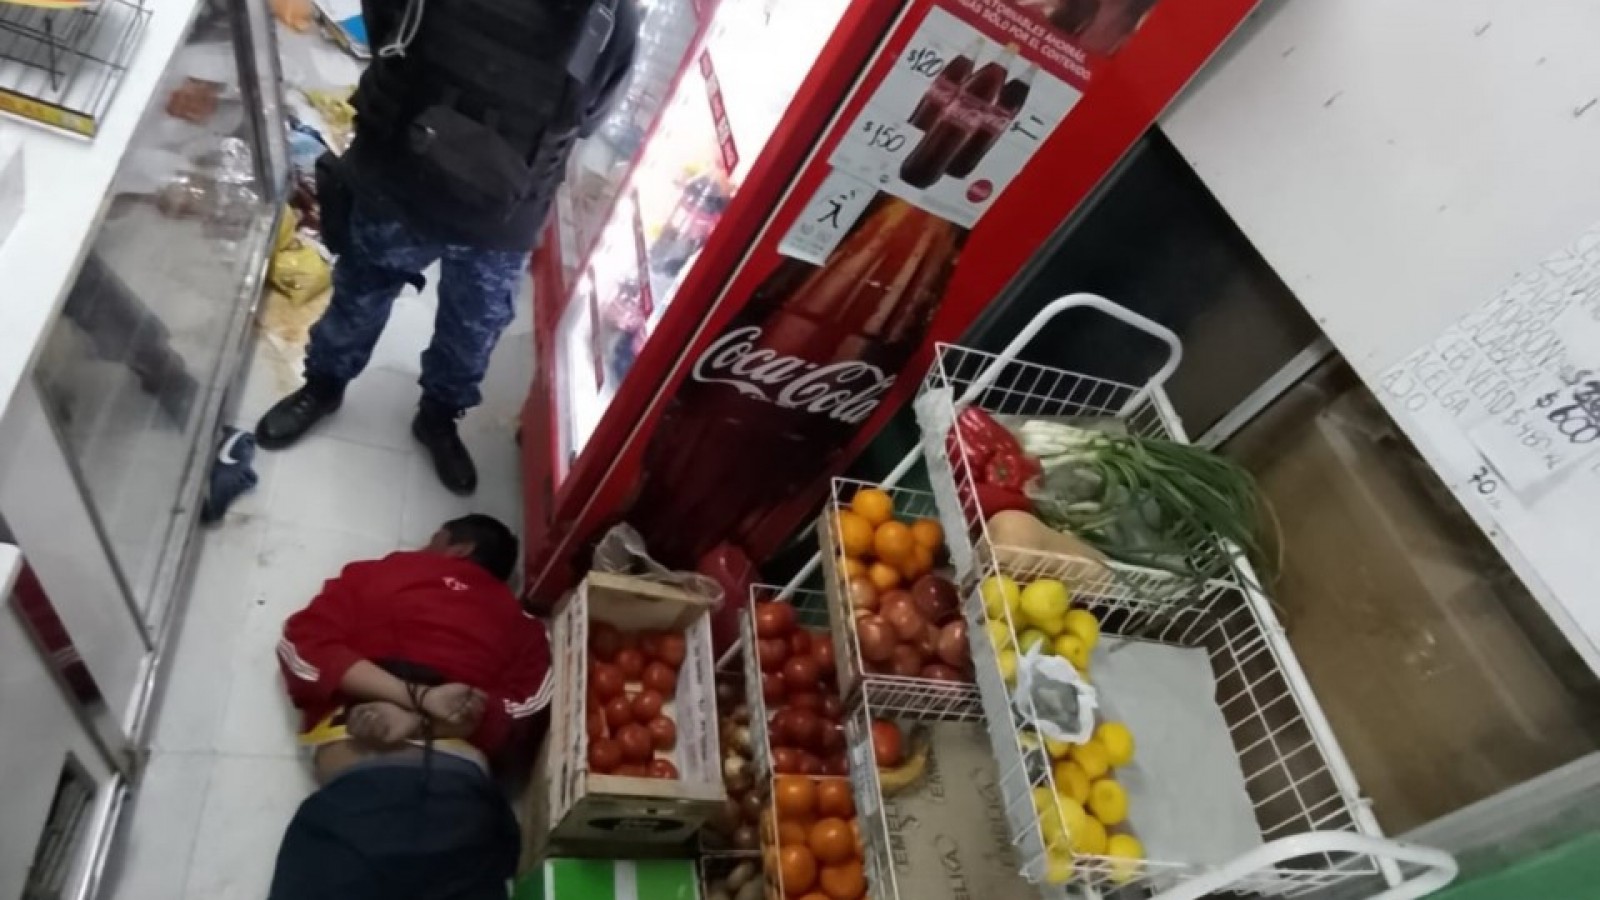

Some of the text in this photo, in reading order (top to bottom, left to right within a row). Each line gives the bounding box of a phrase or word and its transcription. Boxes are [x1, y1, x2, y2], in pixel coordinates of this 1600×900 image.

[906, 47, 942, 79] $120
[862, 120, 906, 153] $150
[692, 326, 898, 424] Coca-Cola
[1381, 368, 1428, 413] AJO
[1406, 350, 1470, 418] ACELGA
